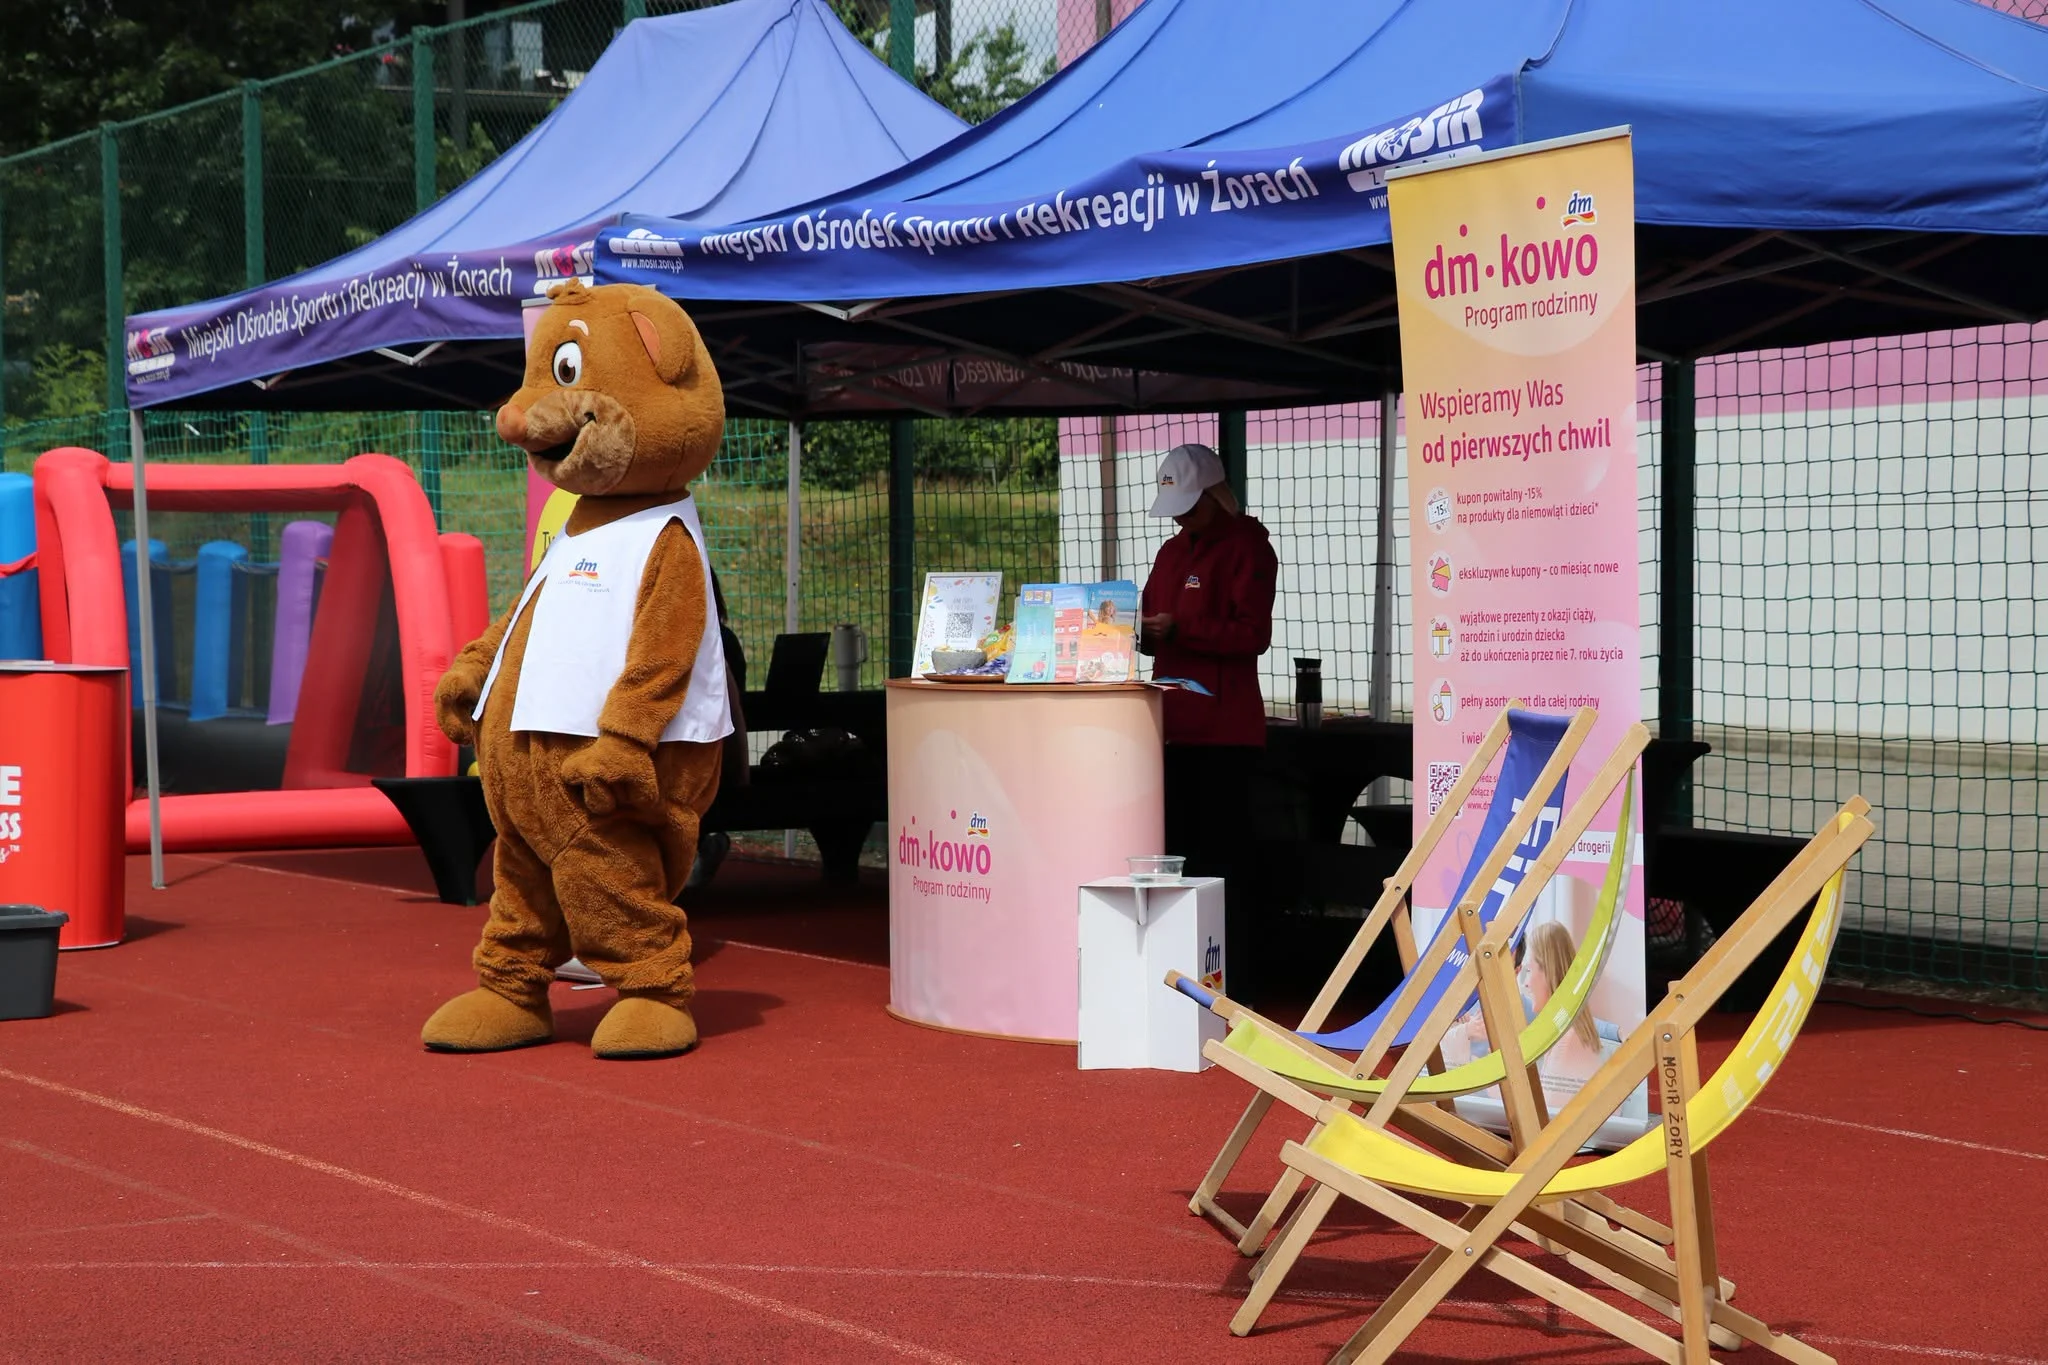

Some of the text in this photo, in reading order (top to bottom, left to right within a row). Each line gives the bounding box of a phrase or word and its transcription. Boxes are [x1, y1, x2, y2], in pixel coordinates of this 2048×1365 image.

[792, 209, 902, 252] Ośrodek
[1016, 172, 1165, 232] Rekreacji
[1174, 182, 1200, 217] w
[1201, 159, 1320, 212] Żorach
[1568, 192, 1592, 214] dm
[182, 255, 513, 362] Miejski Ośrodek Sportu i Rekreacji w Żorach
[1465, 291, 1598, 328] Program rodzinny
[1420, 379, 1564, 423] Wspieramy Was
[1423, 418, 1611, 467] od pierwszych chwil
[1457, 487, 1542, 506] kupon powitalny -15%
[1458, 513, 1467, 523] na
[1469, 508, 1505, 525] produkty
[1507, 506, 1519, 519] dla
[1521, 504, 1563, 520] niemowląt
[575, 558, 597, 572] dm
[1459, 566, 1509, 581] ekskluzywne
[1511, 565, 1541, 580] kupony
[1550, 566, 1558, 576] co
[1560, 562, 1591, 576] miesiąc
[1594, 562, 1619, 574] nowe
[1460, 607, 1596, 627] wyjątkowe prezenty z okazji ciąży,
[1460, 630, 1495, 643] narodzin
[1502, 629, 1533, 641] urodzin
[1535, 628, 1565, 641] dziecka
[1460, 647, 1623, 663] aż do ukończenia przez nie 7. roku życia
[1461, 695, 1483, 709] pełny
[1533, 694, 1546, 707] dla
[1548, 694, 1567, 709] całej
[1569, 694, 1599, 710] rodziny
[1467, 731, 1486, 744] wiel
[970, 813, 986, 828] dm
[1577, 838, 1610, 855] drogerii
[913, 875, 991, 904] Program rodzinny
[1205, 935, 1220, 974] dm
[1663, 1056, 1680, 1105] MOSIR
